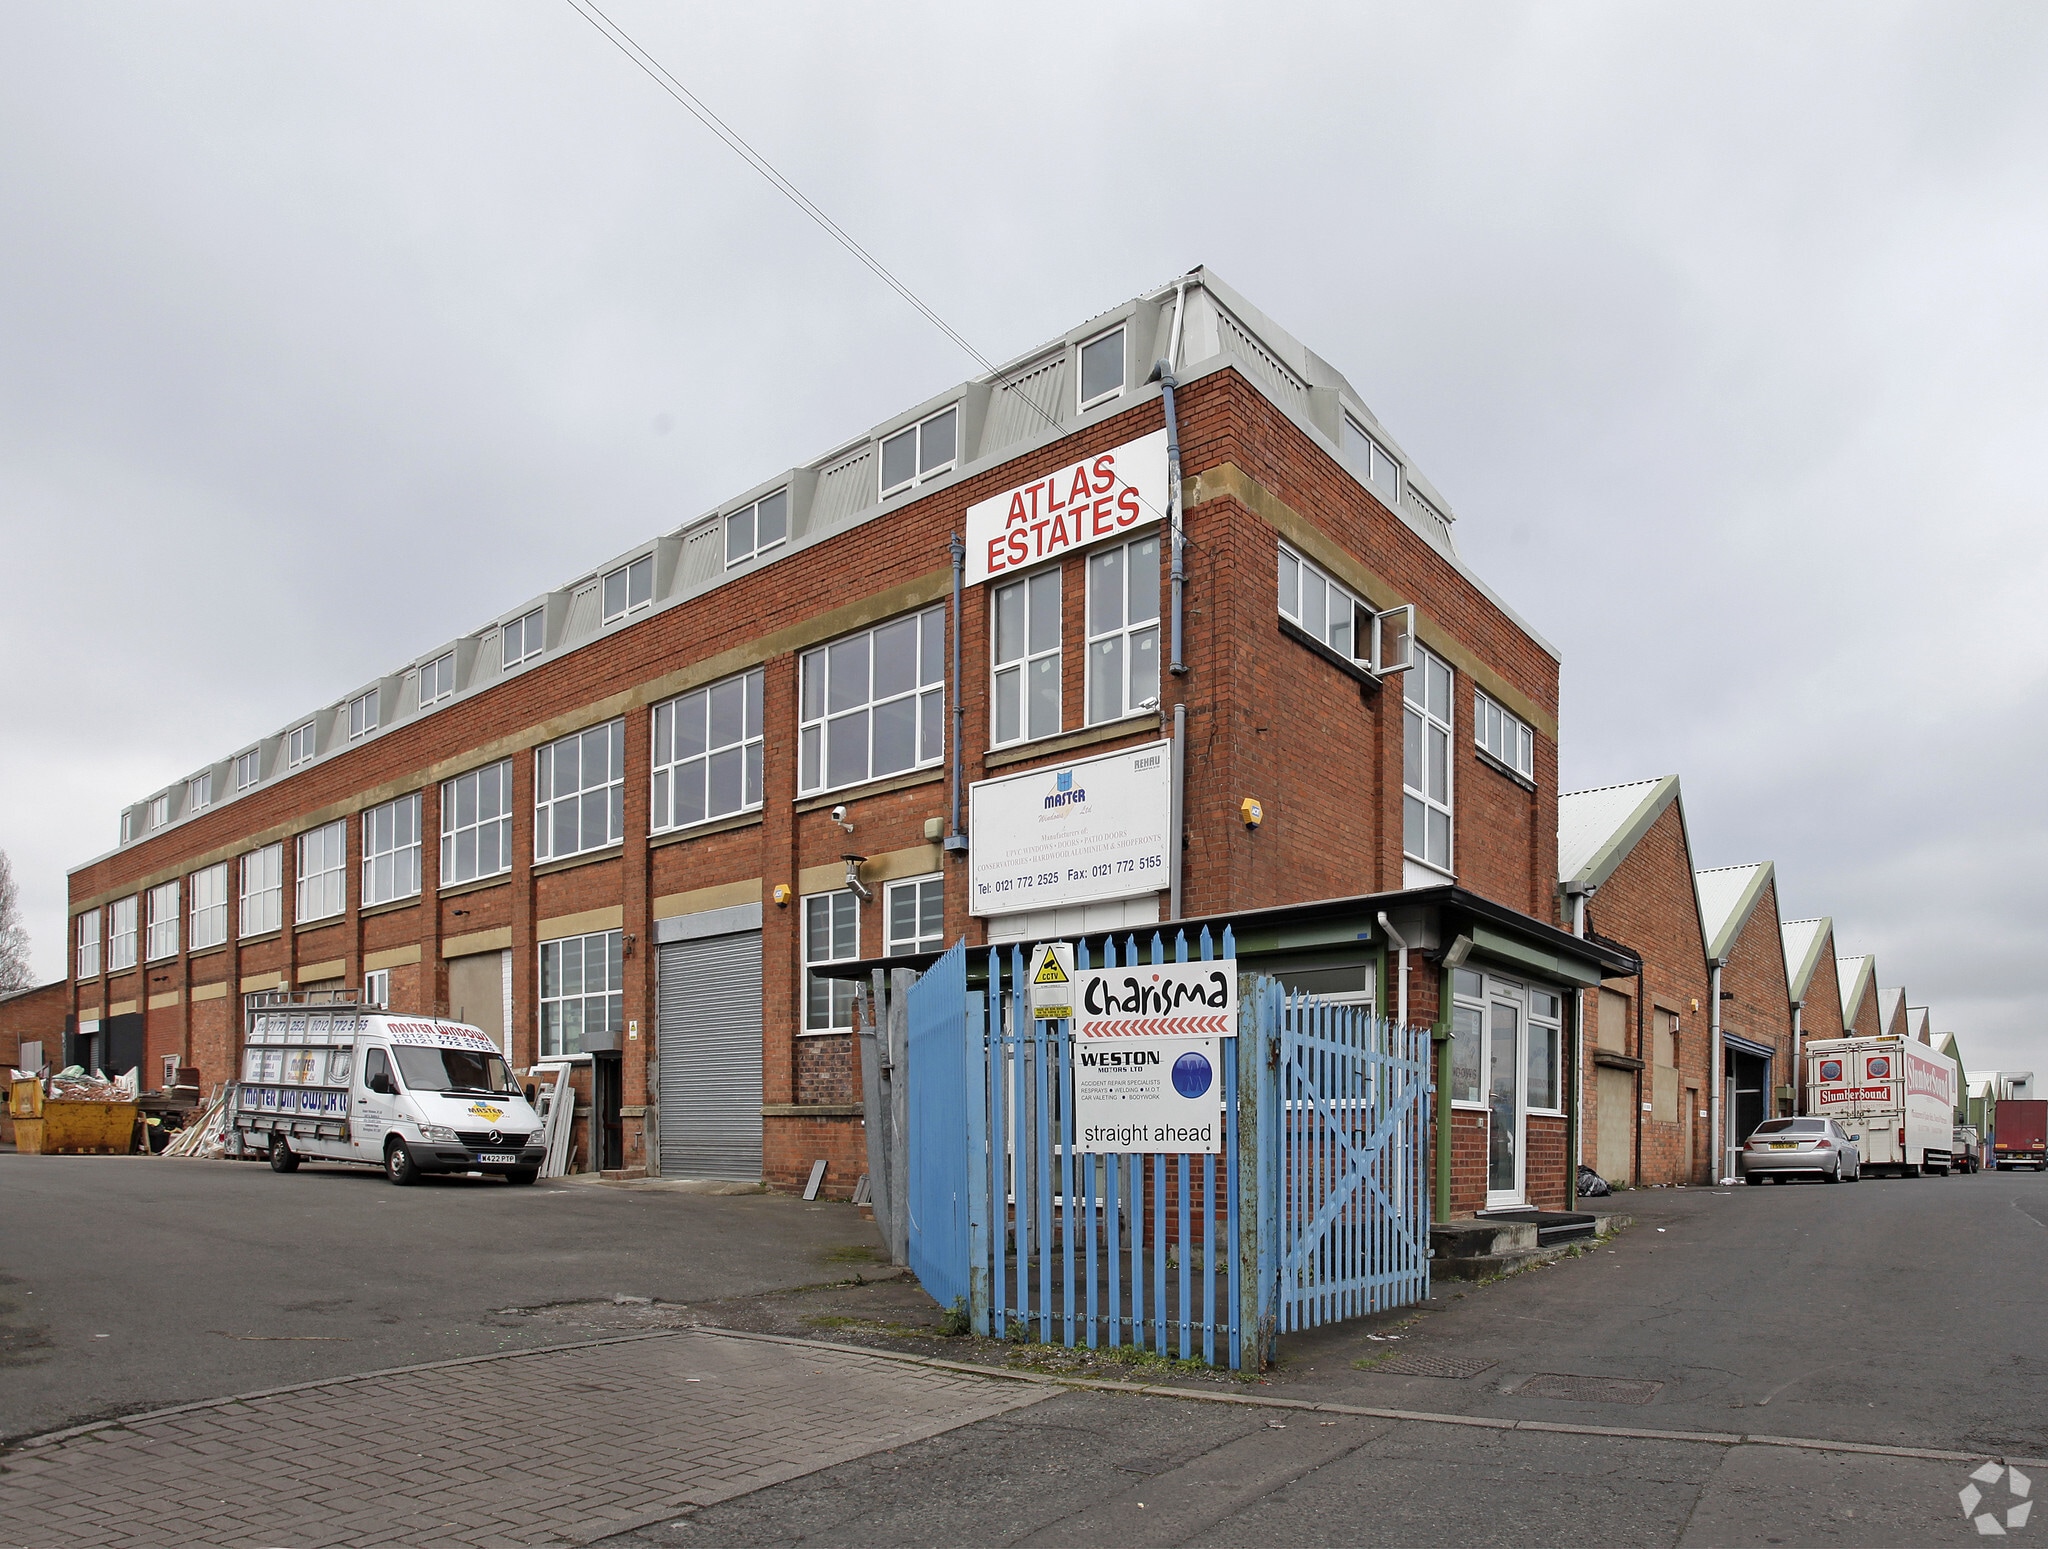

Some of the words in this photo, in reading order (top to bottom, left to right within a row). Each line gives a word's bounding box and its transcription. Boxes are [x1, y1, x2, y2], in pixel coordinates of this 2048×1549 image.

[1005, 455, 1115, 529] ATLAS
[988, 487, 1140, 573] ESTATES
[1134, 755, 1160, 769] REHAU
[1044, 788, 1086, 810] MASTER
[1079, 805, 1093, 815] Ltd
[1006, 848, 1022, 857] UPVC
[1023, 843, 1053, 855] WINDOWS
[1057, 839, 1080, 849] DOORS
[1084, 834, 1103, 844] PATIO
[1104, 830, 1127, 840] DOORS
[1041, 830, 1080, 842] Manufacturers
[977, 857, 1028, 872] CONSERVATORIES
[1117, 834, 1162, 849] SHOPFRONTS
[978, 883, 991, 895] Tel:
[995, 879, 1013, 893] 0121
[1017, 876, 1033, 889] 772
[1037, 872, 1059, 886] 2525
[1068, 869, 1088, 881] Fax:
[1092, 863, 1112, 877] 0121
[1116, 859, 1134, 874] 772
[1139, 855, 1161, 870] 5155
[1042, 973, 1058, 981] CCTV
[1084, 971, 1228, 1016] Charisma
[347, 1020, 369, 1031] 555
[387, 1023, 436, 1035] MASTER
[1081, 1050, 1160, 1066] WESTON
[245, 1087, 276, 1106] MATER
[1822, 1087, 1888, 1103] SlumberSound
[1085, 1124, 1148, 1146] straight
[1154, 1124, 1211, 1142] ahead
